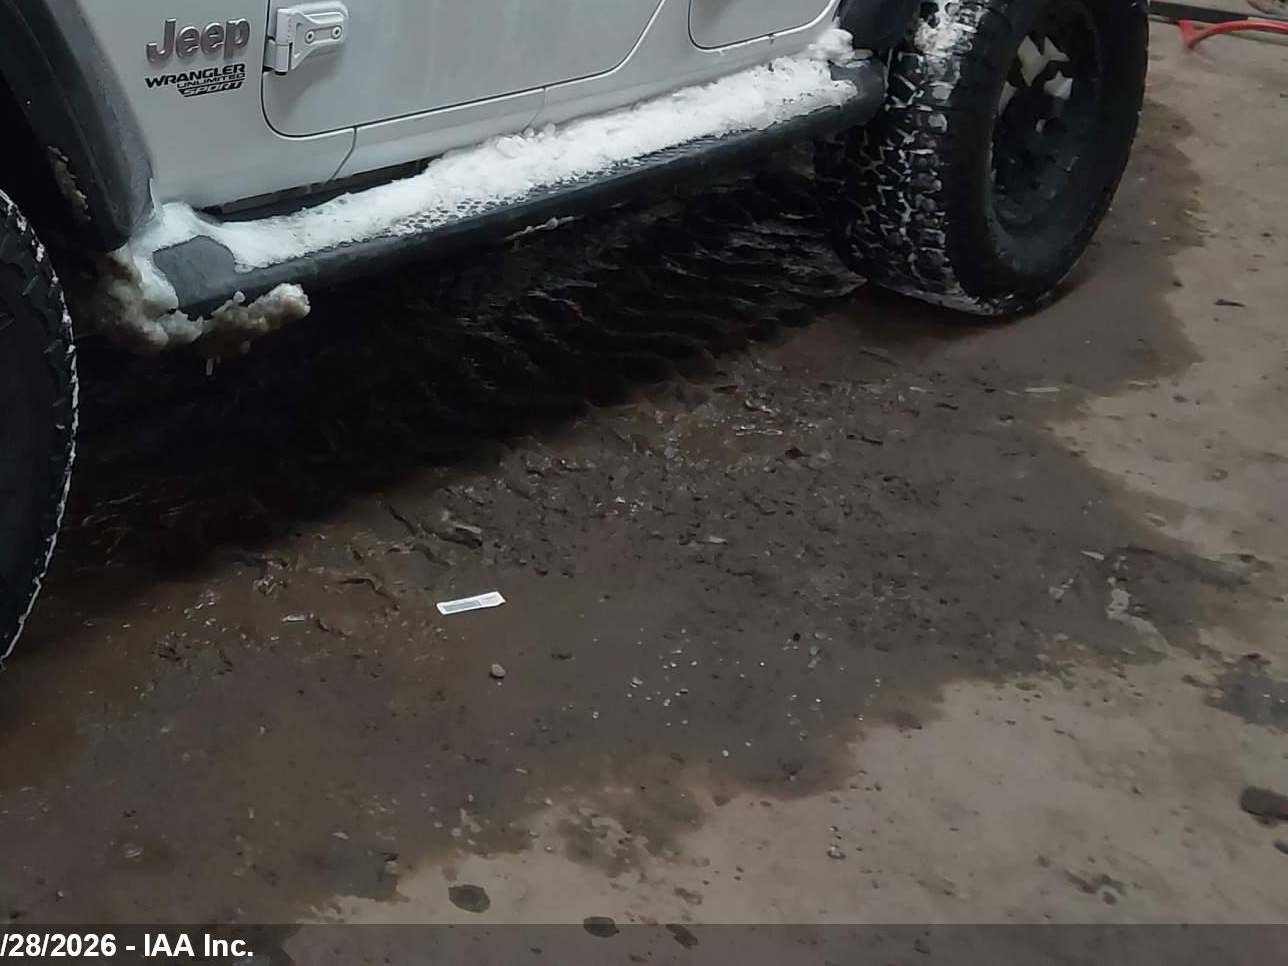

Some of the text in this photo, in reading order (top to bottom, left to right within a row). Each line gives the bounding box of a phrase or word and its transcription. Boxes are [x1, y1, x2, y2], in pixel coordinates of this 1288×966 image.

[146, 17, 251, 63] Jeep
[144, 63, 246, 88] WRANGLER
[176, 73, 246, 88] UNLIMITED
